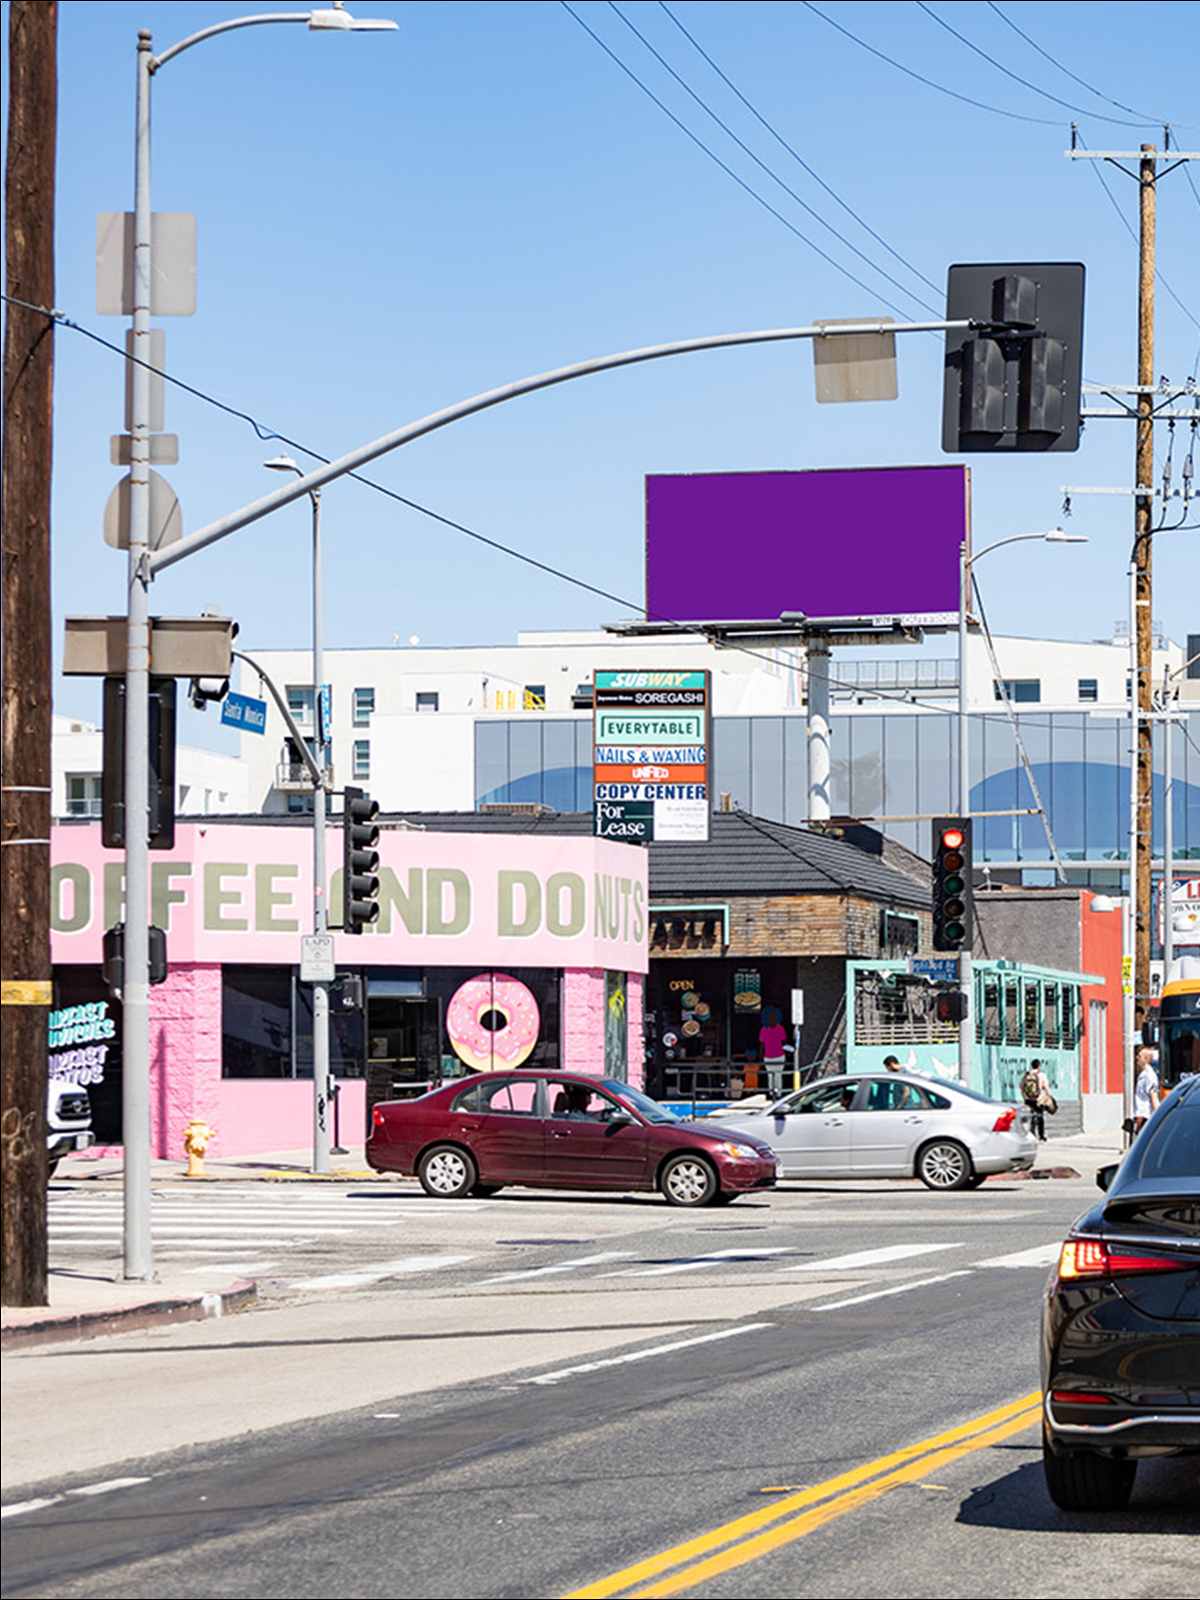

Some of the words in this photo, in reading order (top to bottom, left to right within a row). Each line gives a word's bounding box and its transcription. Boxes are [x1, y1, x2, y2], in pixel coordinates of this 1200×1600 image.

[610, 673, 691, 687] SUBWAY
[635, 693, 703, 704] SOREGASHI
[224, 700, 242, 721] Santa
[607, 722, 693, 735] EVERYTABLE
[596, 747, 636, 763] NAILS
[638, 750, 649, 763] &
[652, 746, 707, 763] WAXING
[597, 784, 640, 799] COPY
[644, 784, 706, 800] CENTER
[596, 802, 625, 819] For
[596, 819, 645, 836] Lease
[669, 980, 695, 991] OPEN
